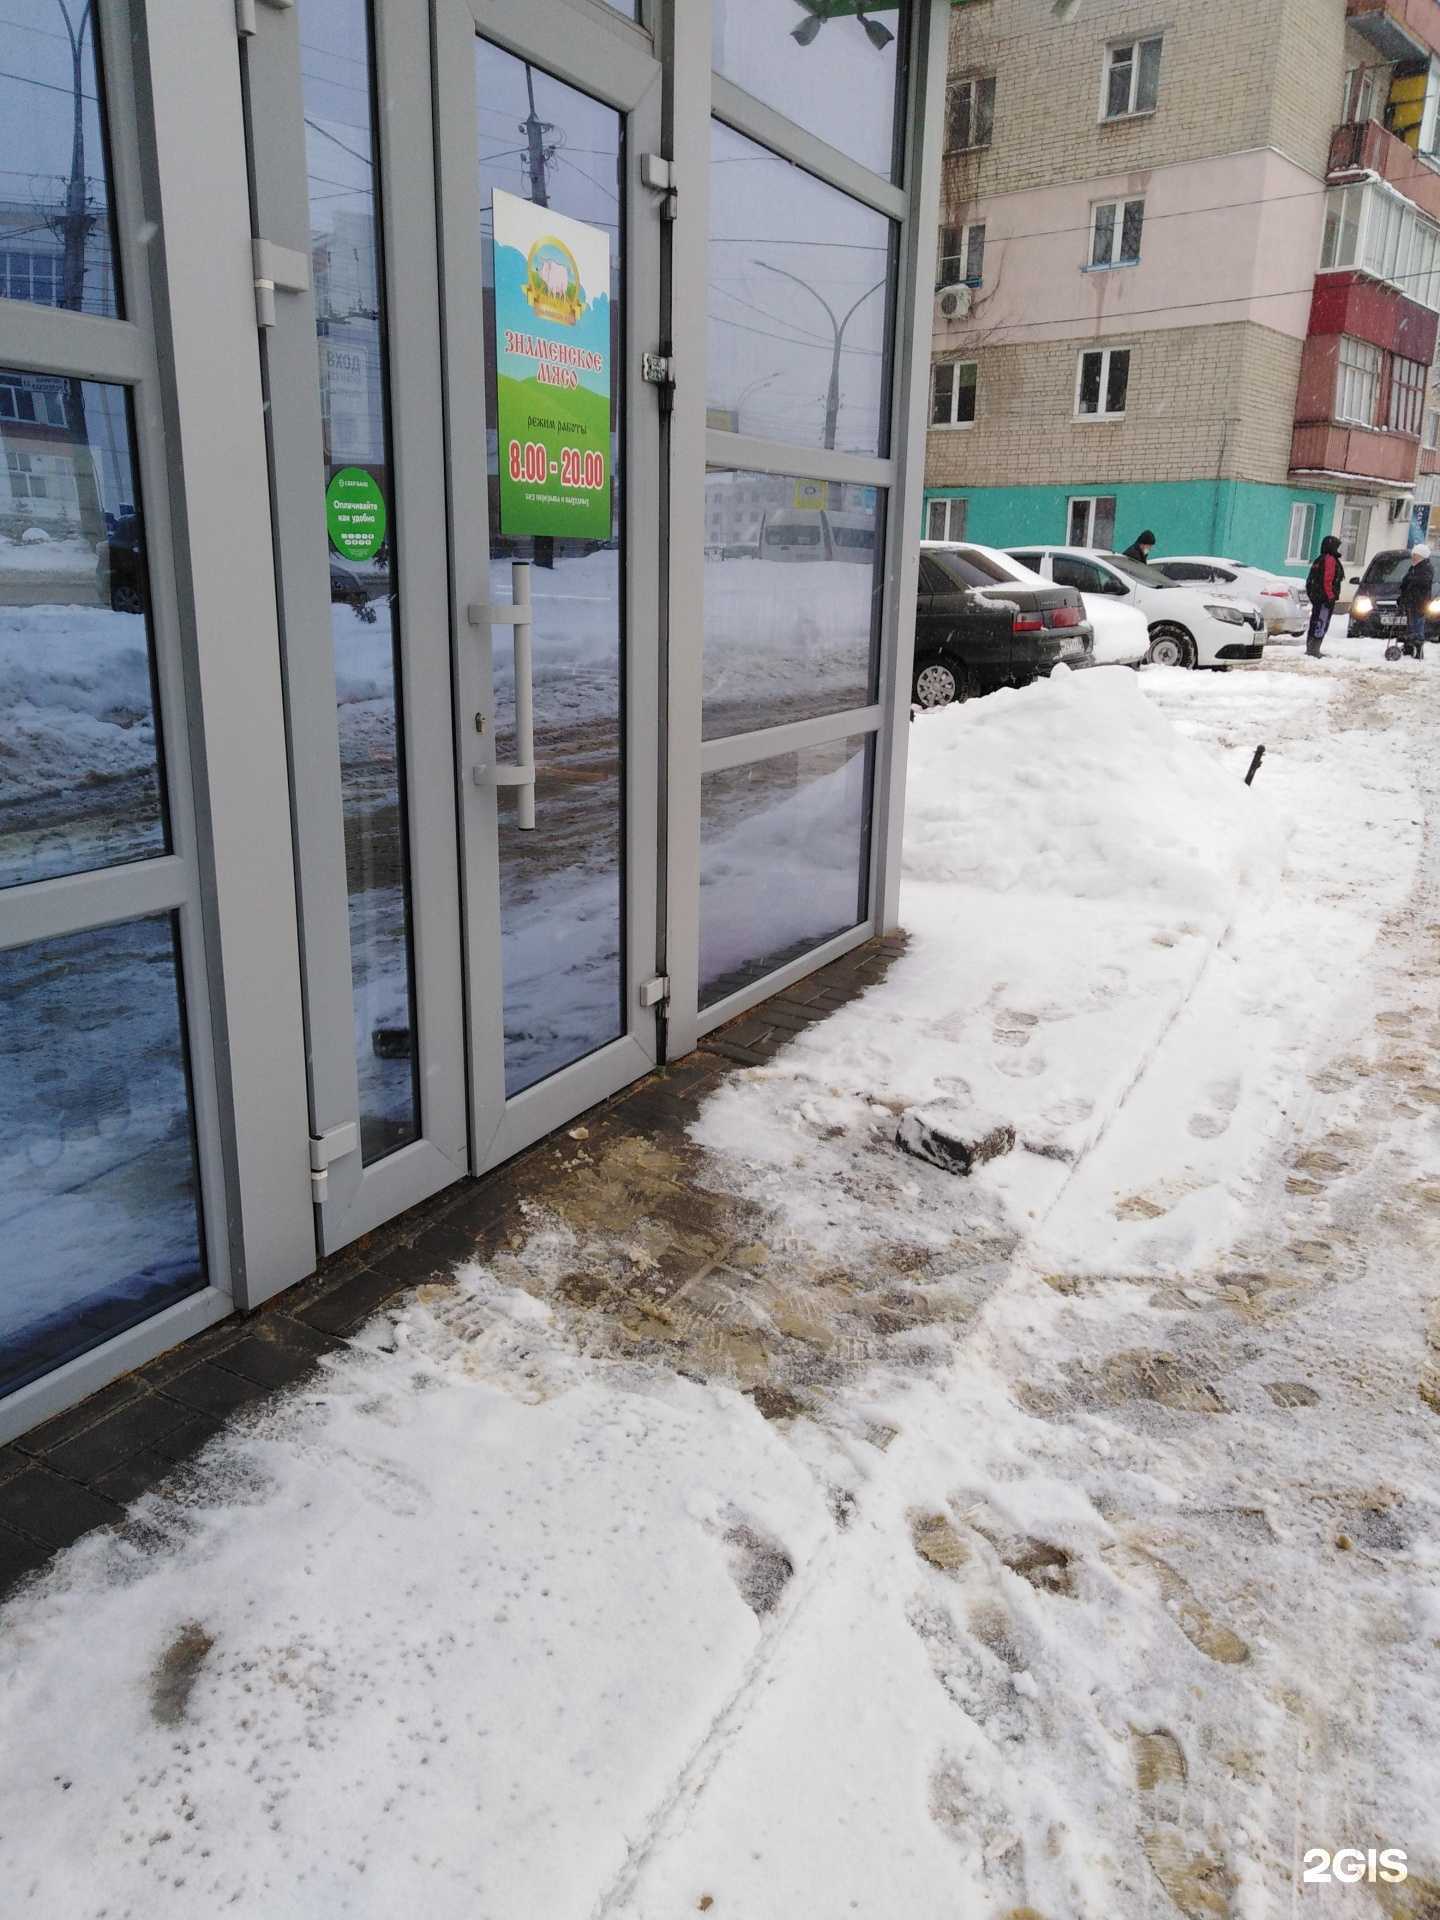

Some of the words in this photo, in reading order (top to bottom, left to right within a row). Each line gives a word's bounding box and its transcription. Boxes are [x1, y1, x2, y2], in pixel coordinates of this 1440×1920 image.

[504, 329, 602, 373] ЗНАМЕНСКОЕ
[537, 361, 578, 390] МЯСО
[509, 440, 547, 484] 8.00
[561, 447, 604, 490] 20.00
[351, 513, 376, 523] удобно
